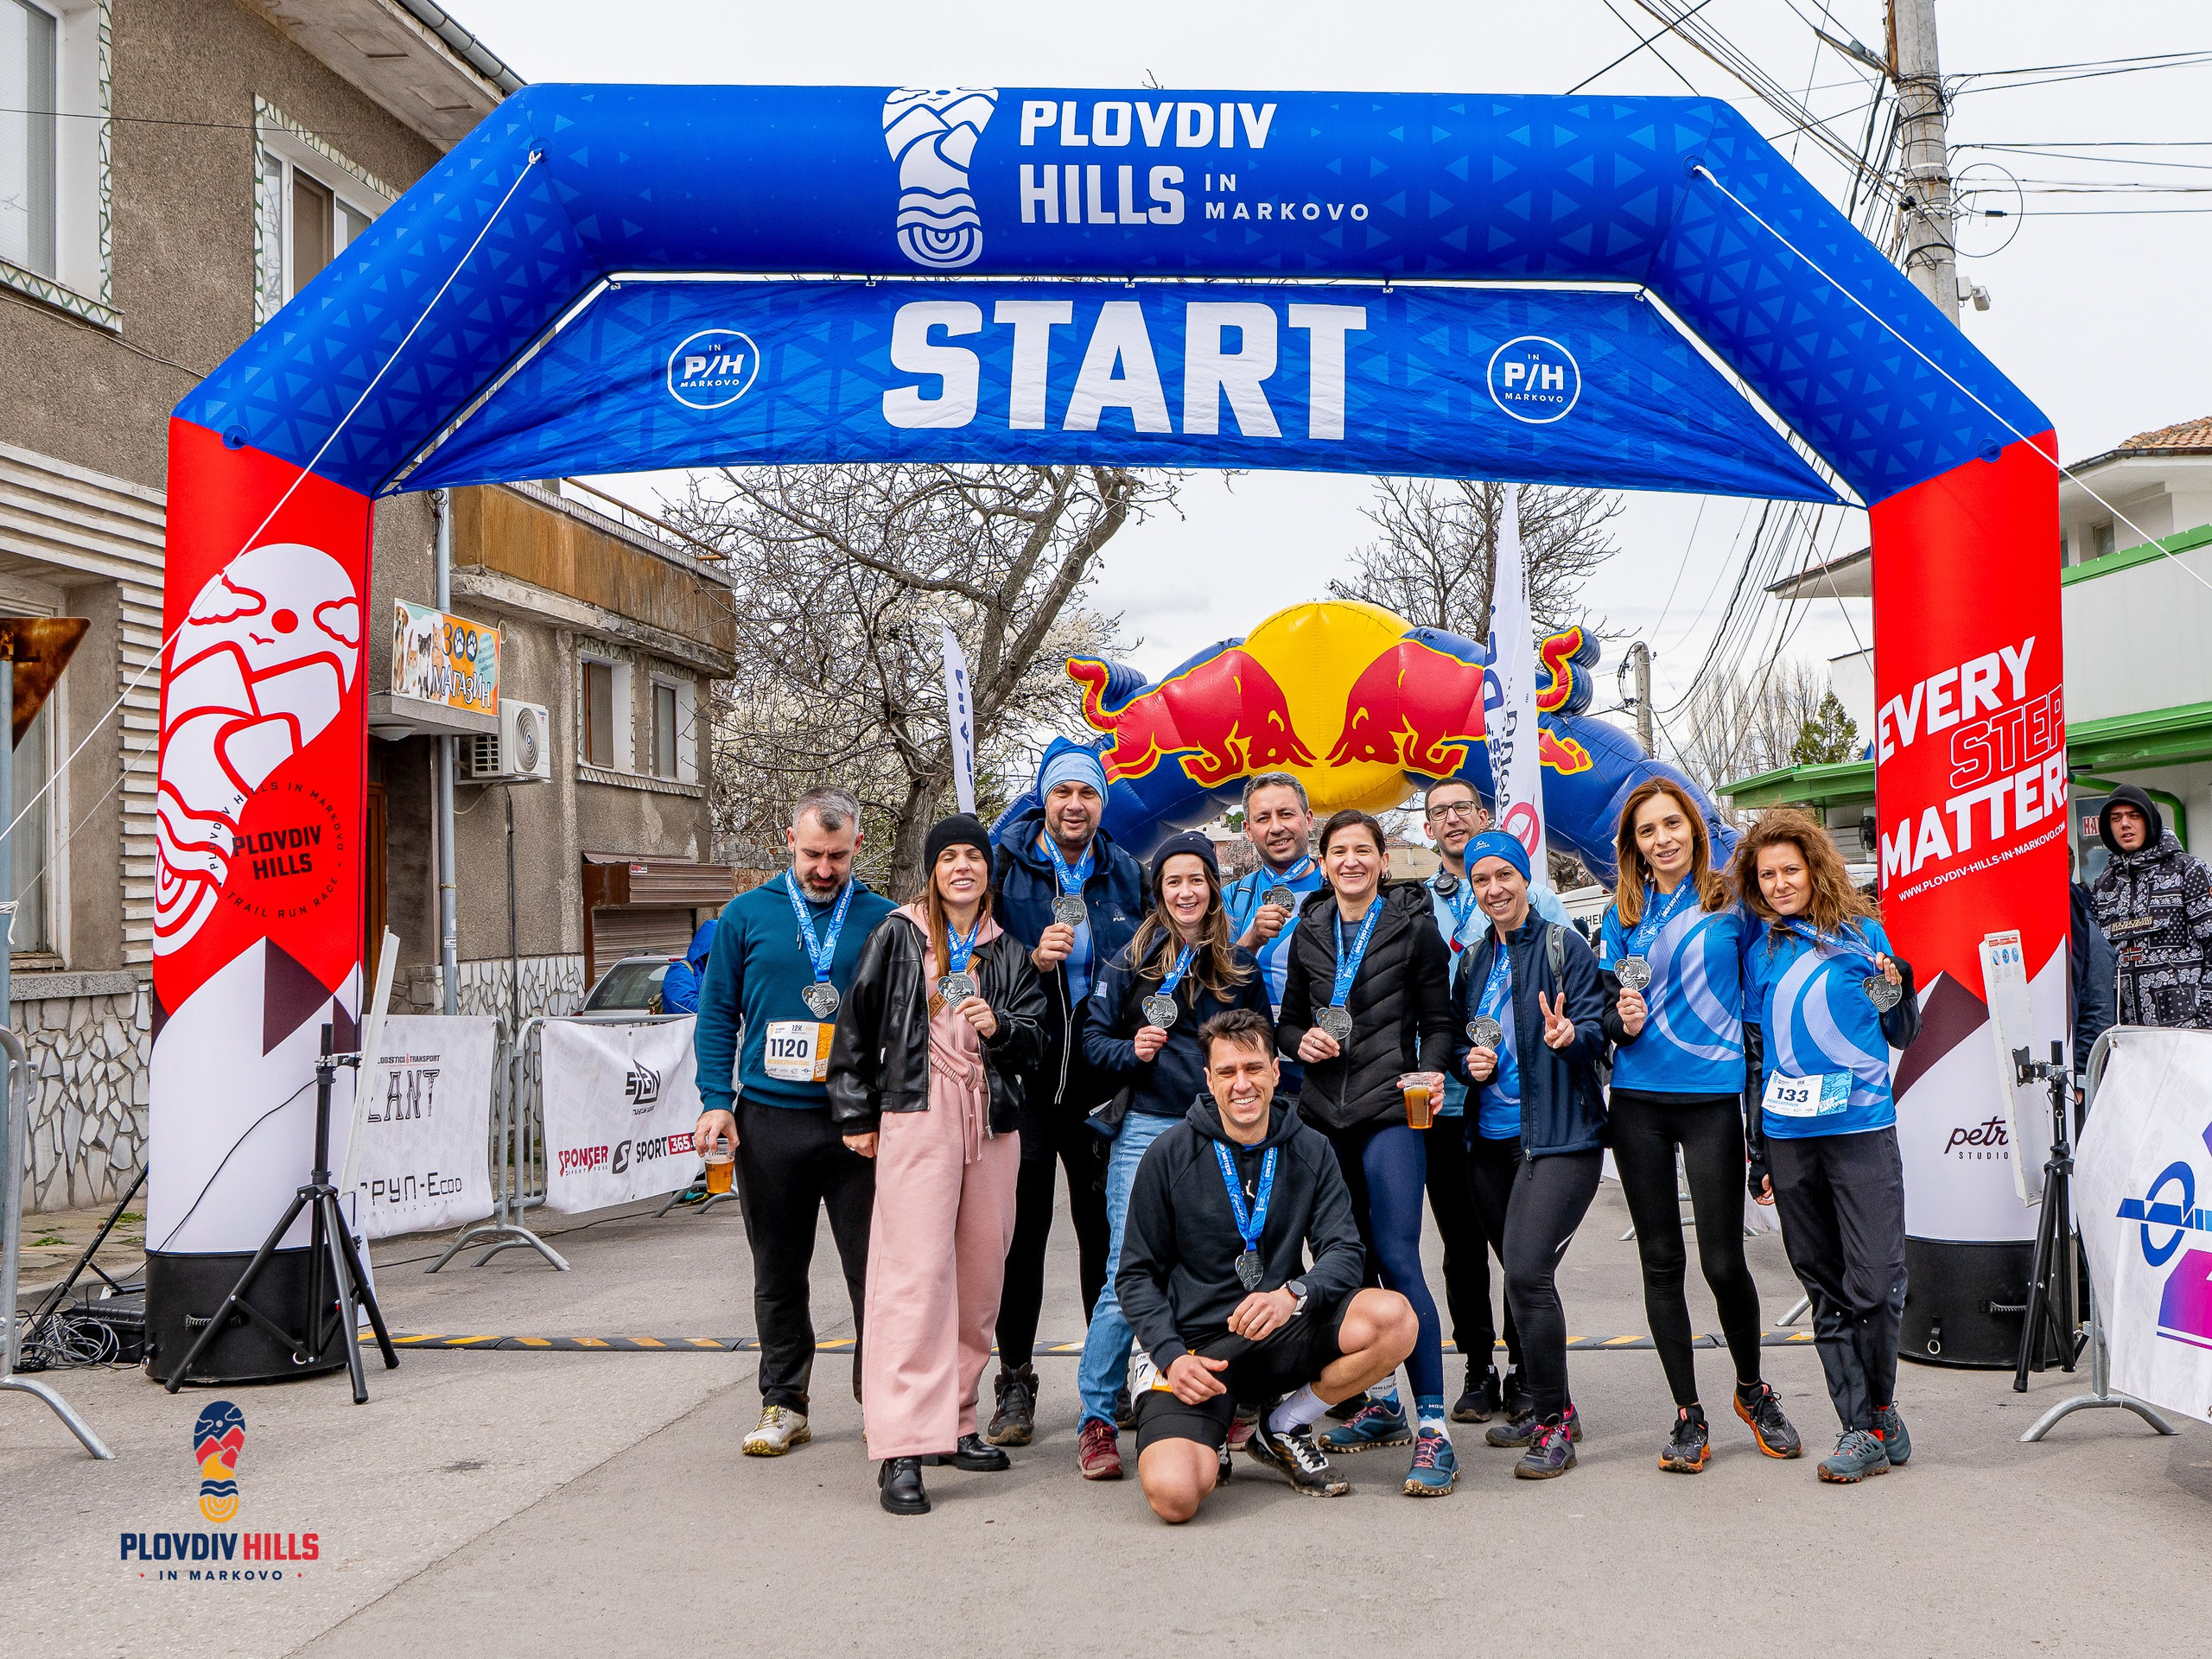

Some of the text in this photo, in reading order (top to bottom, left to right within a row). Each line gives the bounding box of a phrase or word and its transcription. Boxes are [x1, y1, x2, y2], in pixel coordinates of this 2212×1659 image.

[1020, 100, 1277, 149] PLOVDIV
[1020, 164, 1185, 224] HILLS
[1205, 174, 1236, 192] IN
[1205, 202, 1369, 221] MARKOVO
[683, 353, 745, 379] P/H
[882, 301, 1367, 440] START
[1504, 362, 1564, 391] P/H
[680, 379, 740, 388] MARKOVO
[1505, 392, 1564, 404] MARKOVO
[432, 664, 492, 708] МАГАЗИН
[1878, 636, 2036, 767] EVERY
[1950, 683, 2064, 790] STEP
[208, 782, 343, 870] PLOVDIV HILLS IN MARKOVO
[232, 825, 321, 857] PLOVDIV
[252, 853, 312, 880] HILLS
[1898, 821, 2066, 901] WWW.PLOVDIV-HILLS-IN-MARKOVO.COM
[227, 876, 338, 918] TRAIL RUN RACE
[771, 1039, 809, 1058] 1120
[1777, 1087, 1808, 1103] 133
[558, 1146, 608, 1177] SPONSER
[636, 1136, 667, 1164] SPORT
[1959, 1151, 2009, 1160] STUDIO
